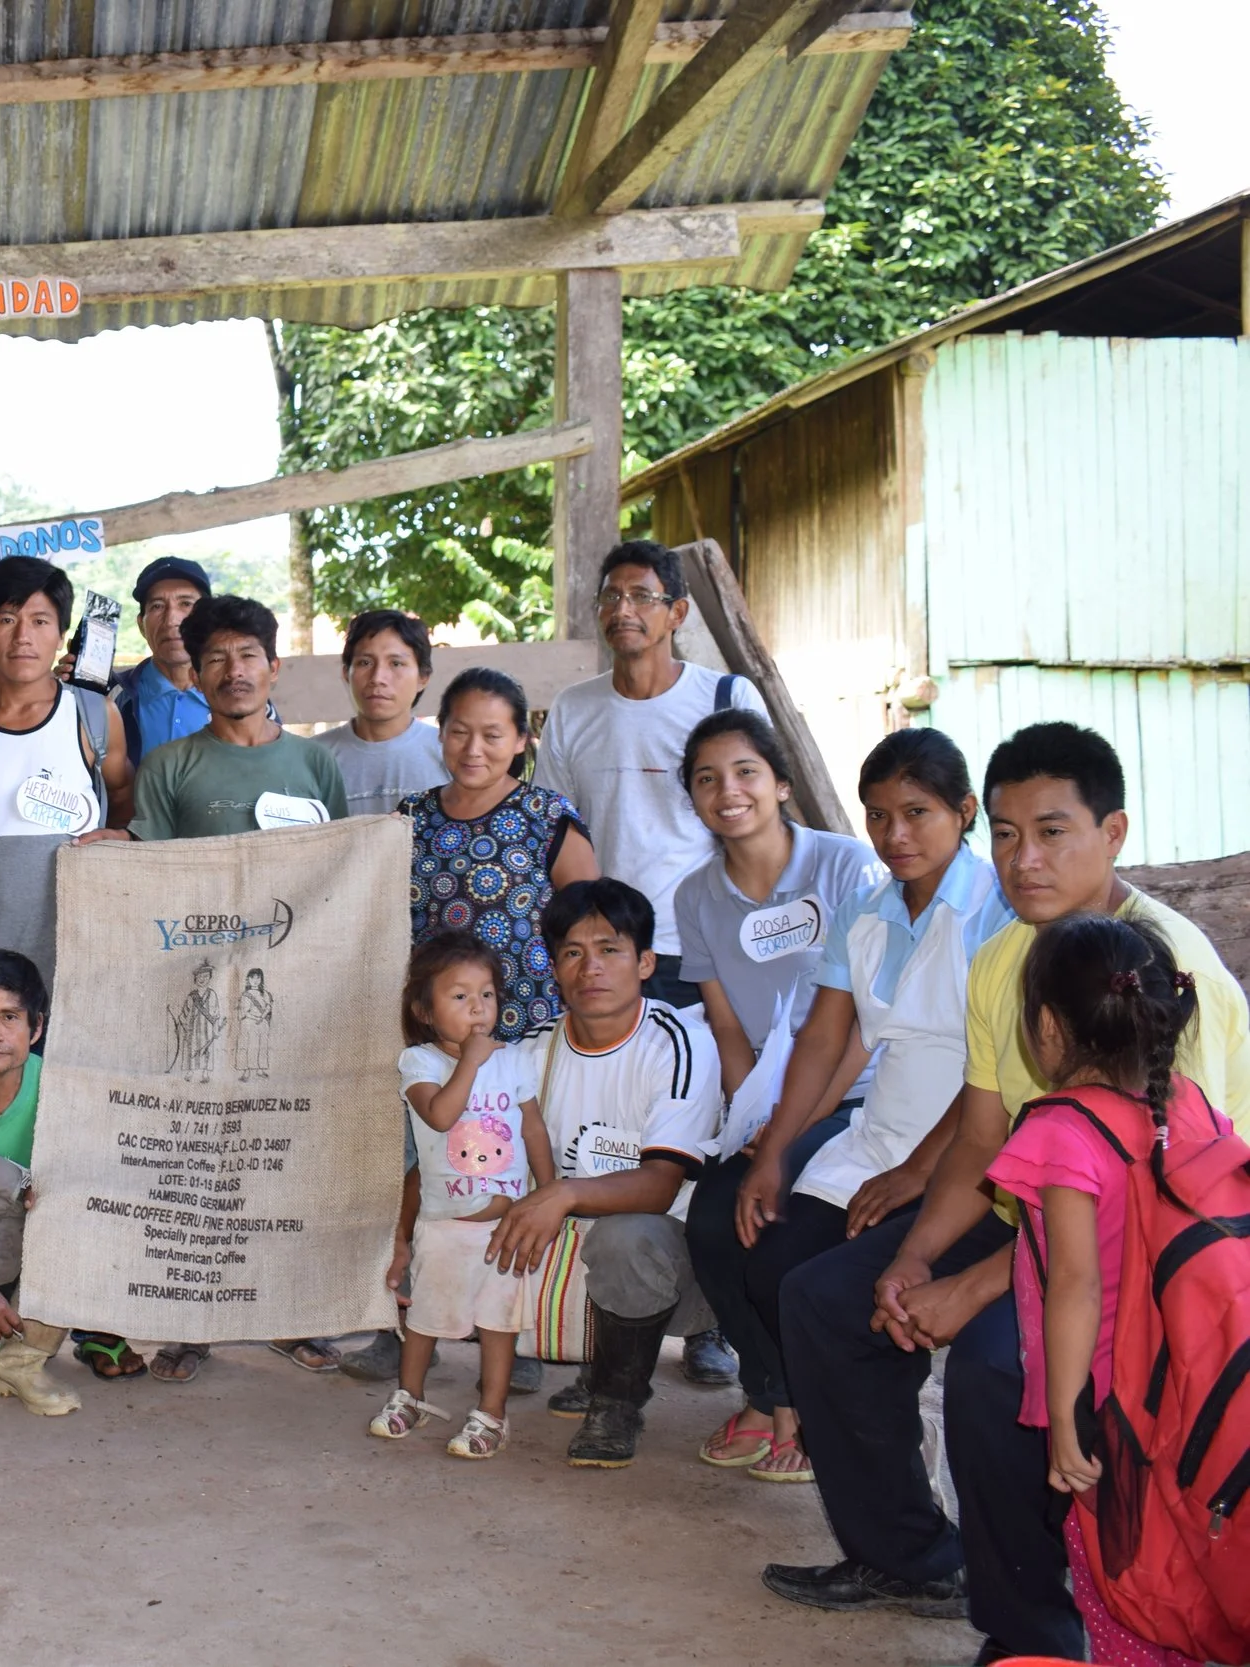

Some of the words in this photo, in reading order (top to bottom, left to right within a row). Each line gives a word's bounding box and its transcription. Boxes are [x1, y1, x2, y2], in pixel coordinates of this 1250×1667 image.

[24, 780, 79, 811] HERMINIO
[184, 914, 241, 930] CEPRO
[753, 915, 790, 937] ROSA
[154, 919, 275, 951] Yanesha
[756, 926, 813, 957] GORDILLO
[109, 1090, 135, 1106] VILLA
[137, 1094, 160, 1110] RICA
[168, 1099, 183, 1113] AV.
[186, 1101, 223, 1115] PUERTO
[225, 1099, 277, 1114] BERMUDEZ
[279, 1098, 292, 1111] No
[294, 1099, 311, 1111] 825
[170, 1120, 181, 1134] 30
[193, 1122, 209, 1135] 741
[117, 1132, 137, 1148] CAC
[140, 1136, 173, 1152] CEPRO
[594, 1136, 640, 1157] RONALD
[120, 1153, 184, 1169] InterAmerican
[187, 1158, 215, 1172] Coffee
[262, 1158, 283, 1171] 1246
[158, 1174, 186, 1186] LOTE:
[214, 1178, 241, 1192] BAGS
[149, 1188, 198, 1206] HAMBURG
[200, 1196, 246, 1211] GERMANY
[86, 1197, 132, 1217] ORGANIC
[133, 1205, 173, 1224] COFFEE
[174, 1210, 201, 1228] PERU
[202, 1214, 223, 1231] FINE
[226, 1218, 273, 1232] ROBUSTA
[276, 1219, 304, 1232] PERU
[144, 1224, 187, 1245] Specially
[190, 1233, 232, 1248] prepared
[234, 1233, 249, 1245] for
[145, 1244, 212, 1265] InterAmerican
[214, 1251, 246, 1264] Coffee
[128, 1282, 213, 1302] INTERAMERICAN
[216, 1288, 257, 1302] COFFEE
